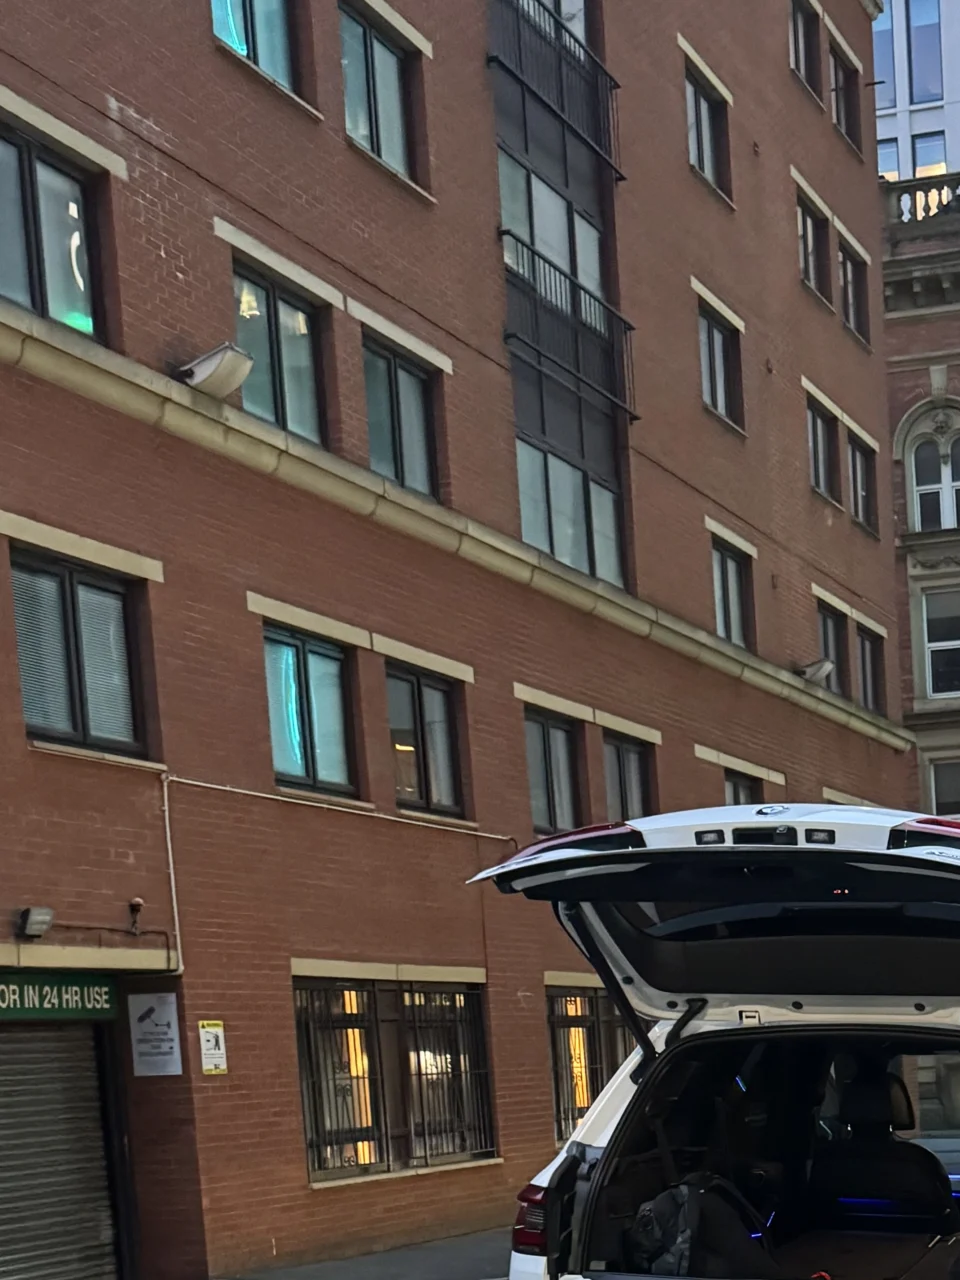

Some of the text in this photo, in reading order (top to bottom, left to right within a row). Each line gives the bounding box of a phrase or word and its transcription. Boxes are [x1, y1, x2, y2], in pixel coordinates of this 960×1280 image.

[24, 984, 40, 1008] IN
[42, 985, 59, 1008] 24
[61, 986, 82, 1009] HR
[84, 986, 111, 1009] USE
